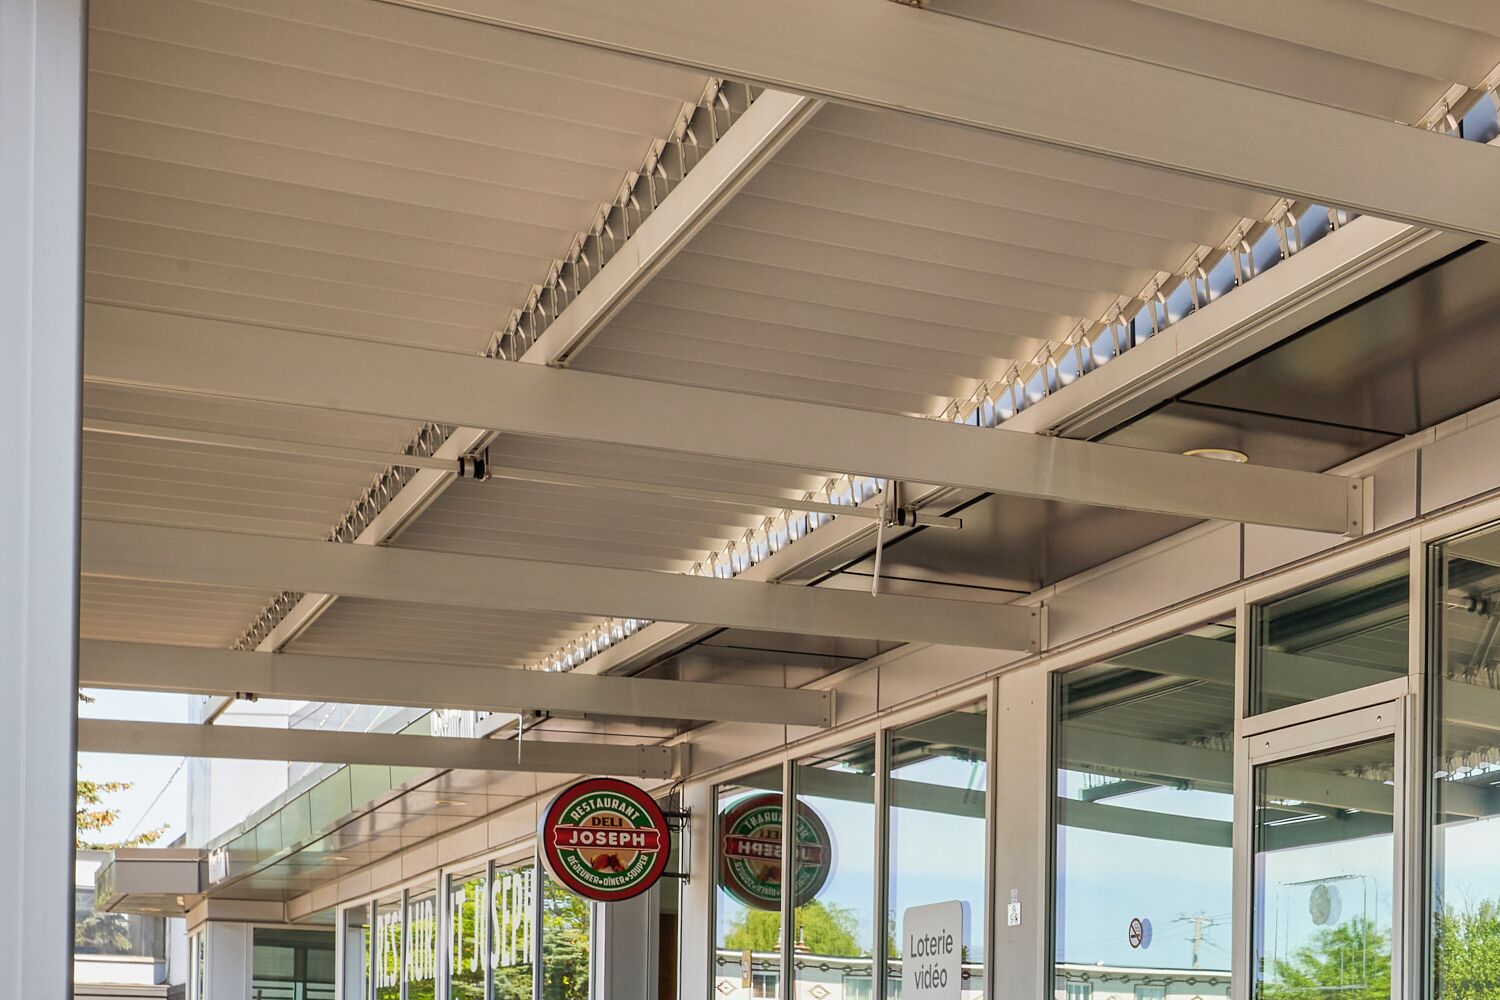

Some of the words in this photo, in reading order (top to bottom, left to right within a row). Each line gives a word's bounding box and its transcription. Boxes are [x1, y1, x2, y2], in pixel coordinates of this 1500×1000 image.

[570, 797, 640, 821] RESTAURANT
[592, 816, 622, 827] DELI
[569, 830, 645, 847] JOSEPH
[567, 855, 599, 884] DÉJEUNER
[603, 876, 626, 886] DÎNER
[627, 854, 649, 879] SOUPER
[910, 929, 953, 958] Loterie
[914, 963, 947, 990] vidéo
